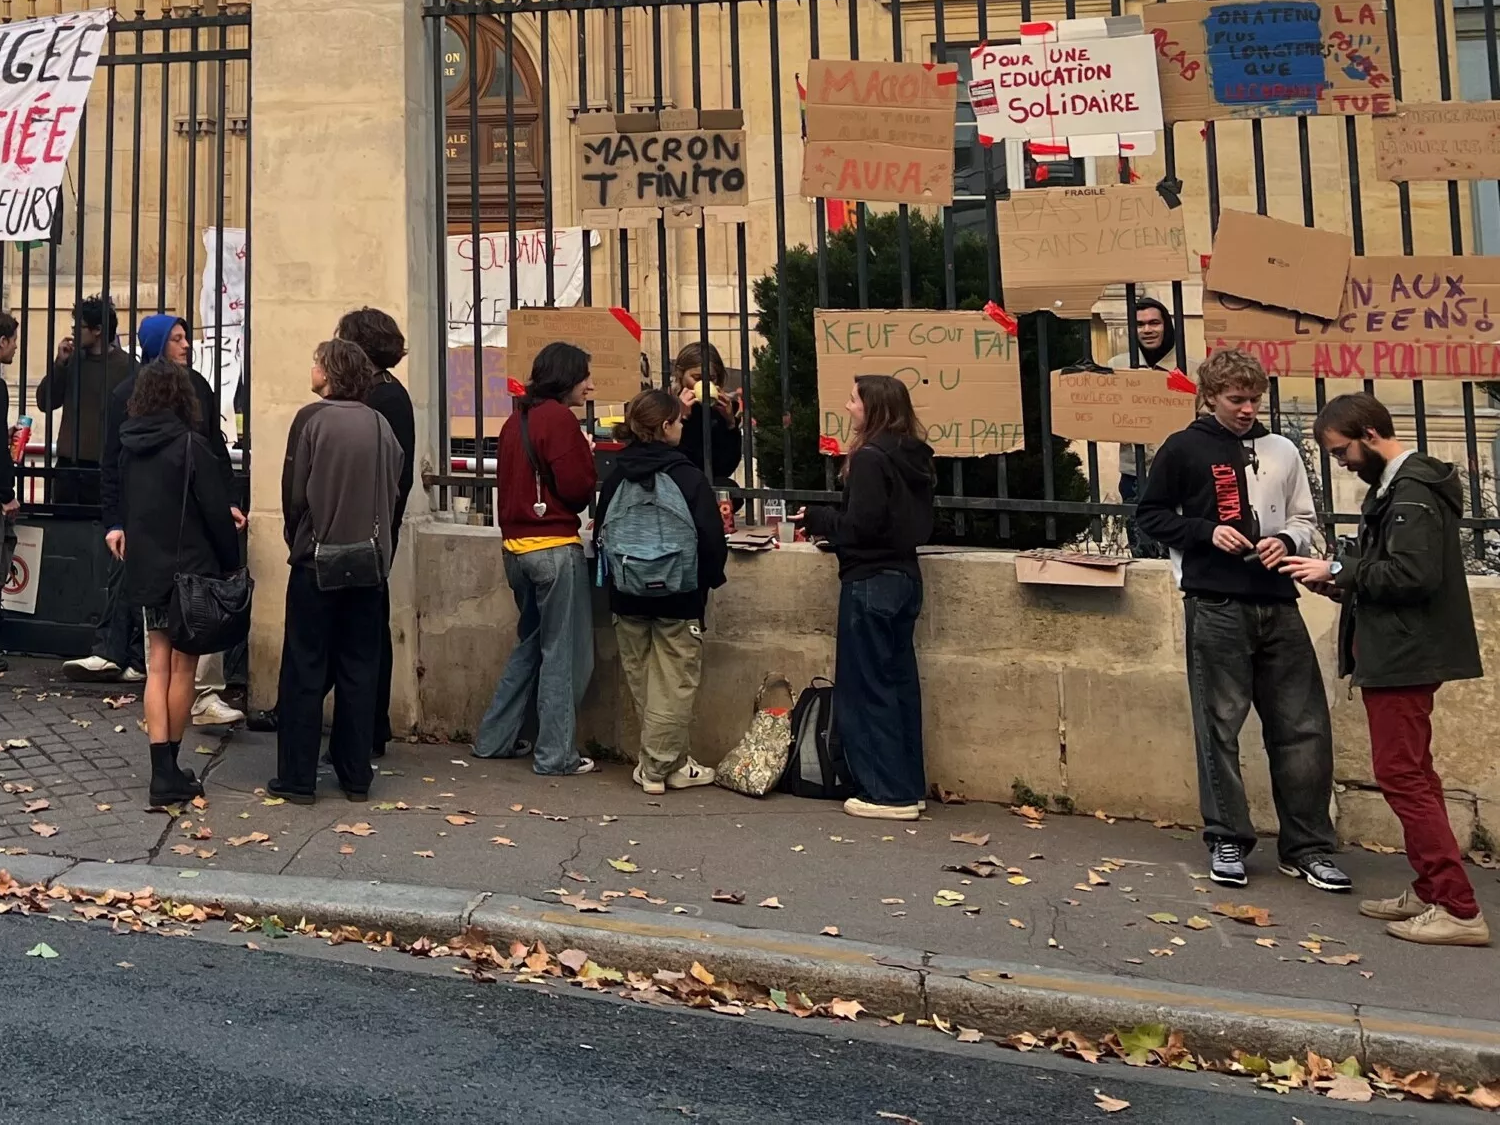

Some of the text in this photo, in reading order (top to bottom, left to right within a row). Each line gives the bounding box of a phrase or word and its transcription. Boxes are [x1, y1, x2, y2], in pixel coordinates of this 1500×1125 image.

[1217, 7, 1321, 25] ON A TENU
[1334, 3, 1376, 25] LA
[1214, 30, 1256, 44] PLUS
[983, 47, 1090, 70] POUR UNE
[1244, 63, 1292, 76] QUE
[819, 67, 951, 104] MACRON
[1332, 93, 1391, 113] TUE
[584, 134, 739, 165] MACRON
[582, 172, 618, 206] T
[836, 159, 922, 195] AURA
[1064, 188, 1106, 197] FRAGILE
[1012, 197, 1082, 231] PAS
[458, 231, 567, 271] SOLIDAIRE
[1012, 232, 1088, 262] SANS
[1391, 273, 1466, 302] AUX
[823, 319, 899, 354] KEUF
[909, 323, 964, 345] GOUT
[1311, 343, 1366, 378] AUX
[1058, 374, 1091, 387] POUR
[1097, 376, 1120, 387] QUE
[1132, 395, 1192, 407] DEVIENNENT
[1075, 412, 1093, 422] DES
[927, 422, 963, 448] OUT
[1211, 464, 1242, 522] SCARFACE
